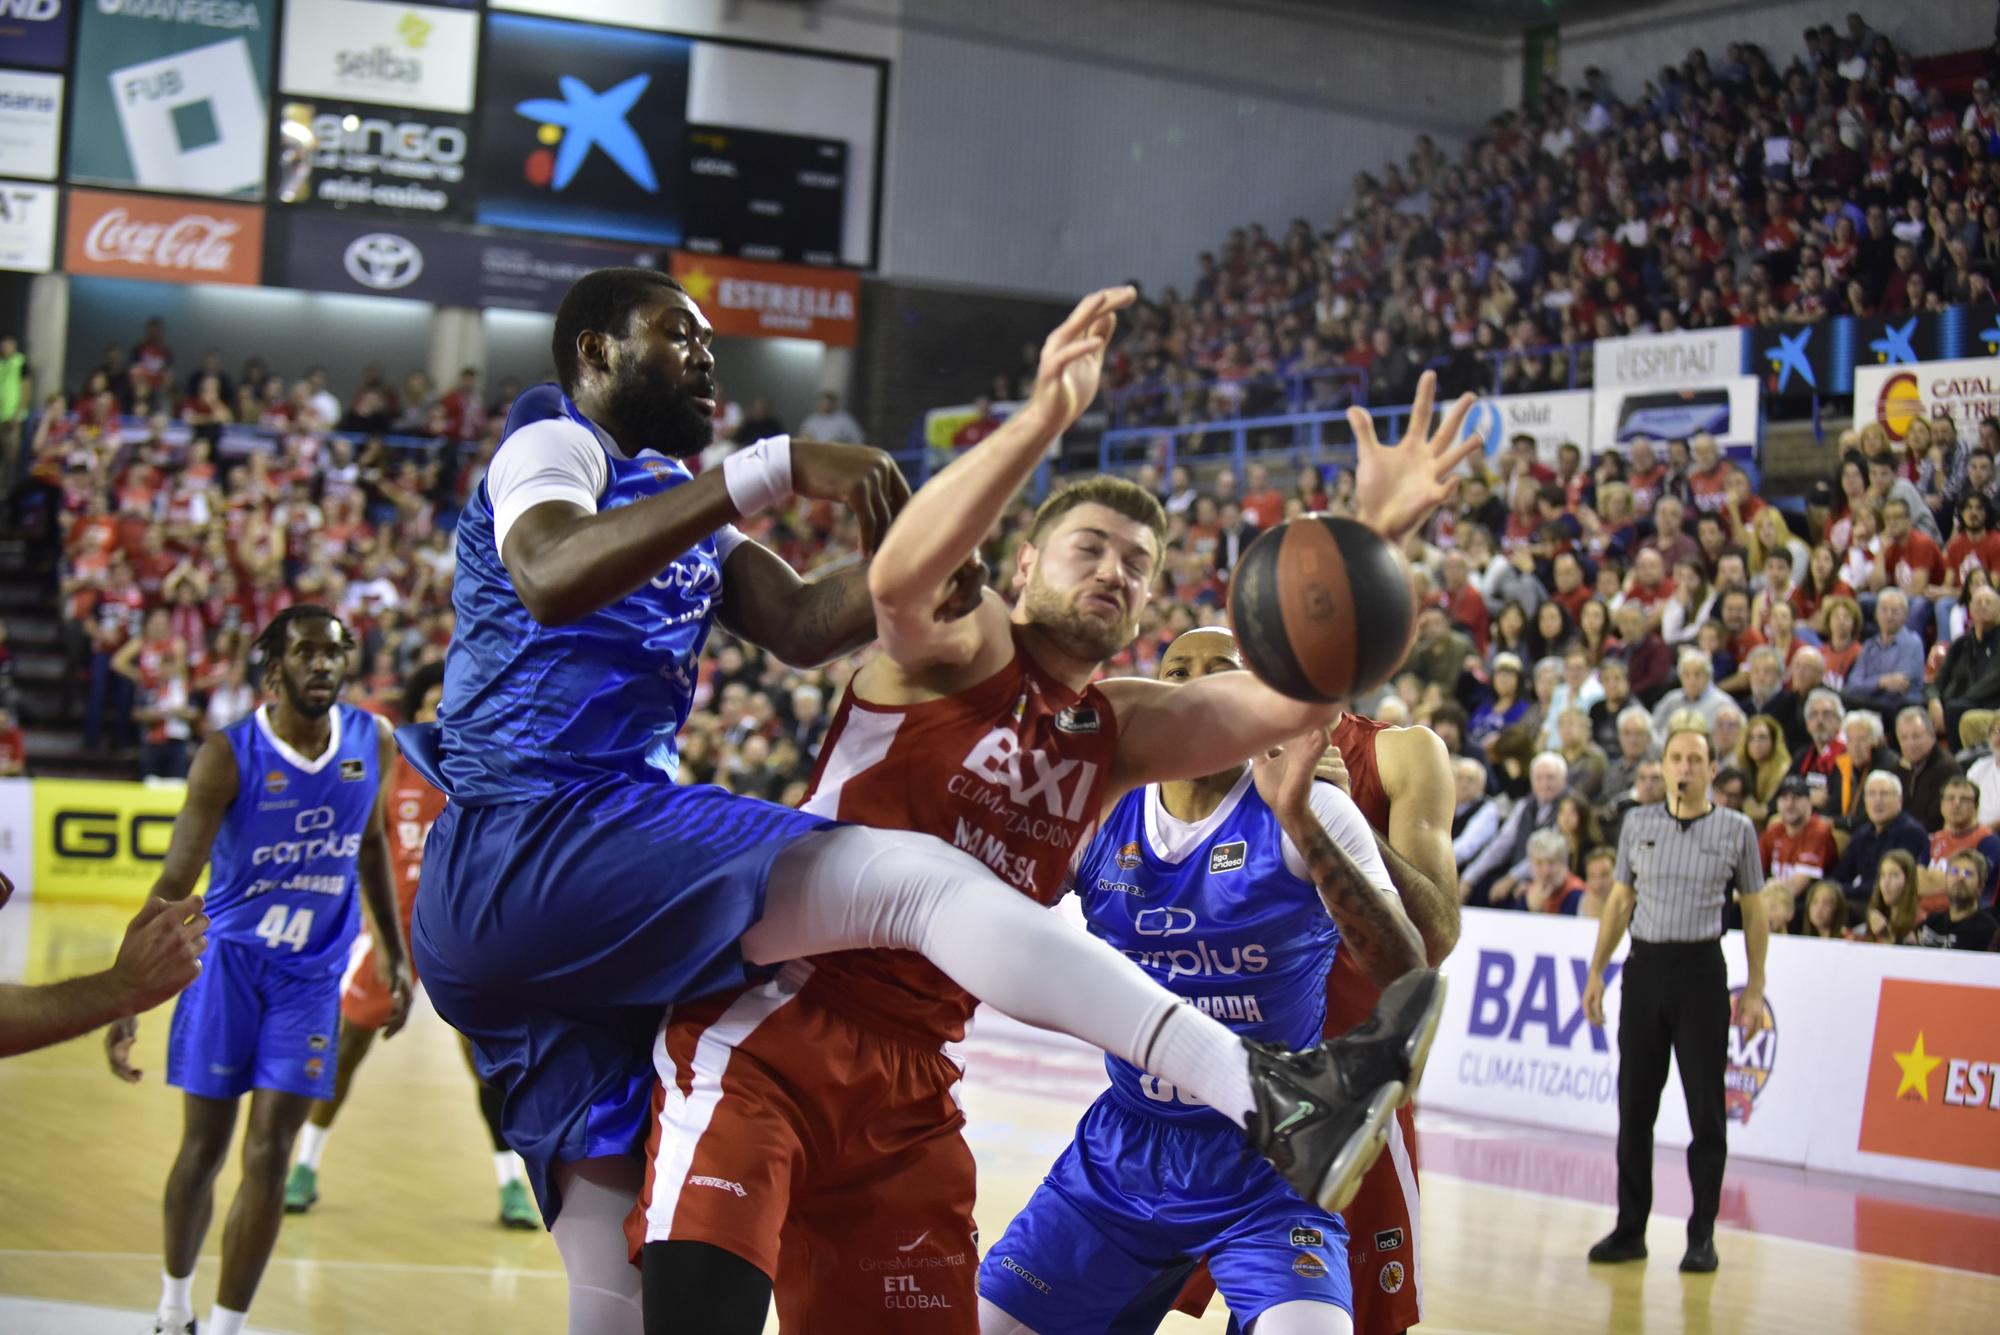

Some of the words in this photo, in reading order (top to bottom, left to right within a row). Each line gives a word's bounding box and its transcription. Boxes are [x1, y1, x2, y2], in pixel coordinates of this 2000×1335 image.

[0, 0, 61, 21] ND
[124, 69, 184, 105] FUB
[718, 278, 855, 319] ESTRELLA
[1932, 376, 2000, 398] CATAL
[1965, 401, 2000, 420] TRE
[256, 904, 314, 952] 44
[1467, 949, 1624, 1053] BAX
[1458, 1048, 1619, 1105] CLIMATIZACIÓ
[1942, 1058, 2000, 1112] EST
[1379, 1237, 1398, 1249] acb
[883, 1275, 921, 1293] ETL
[884, 1295, 952, 1309] GLOBAL
